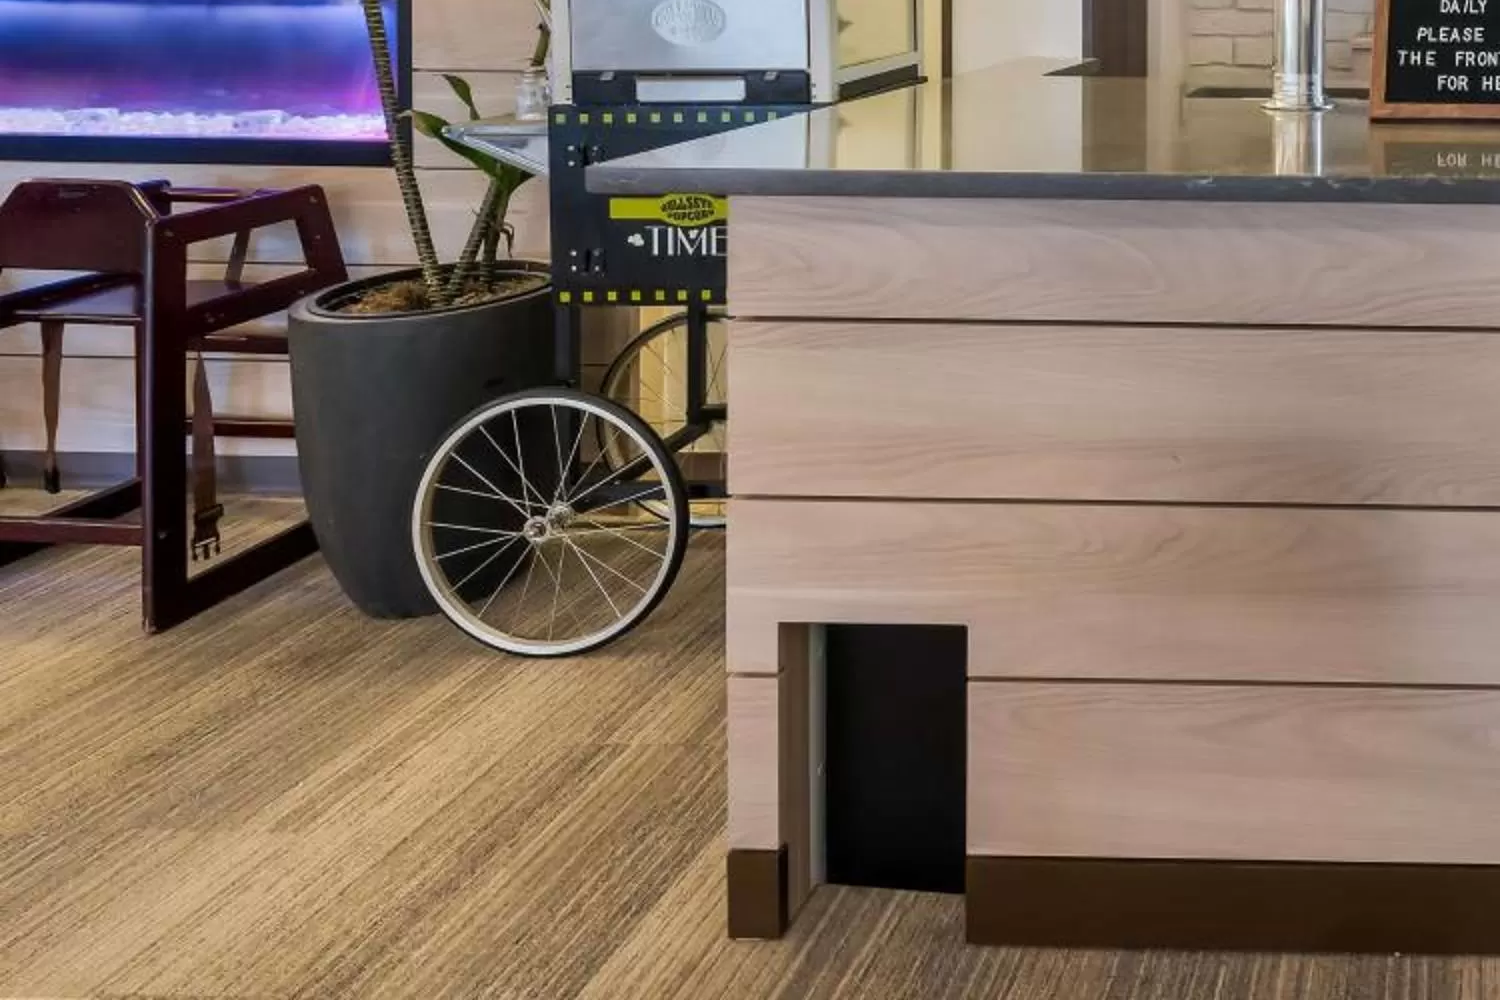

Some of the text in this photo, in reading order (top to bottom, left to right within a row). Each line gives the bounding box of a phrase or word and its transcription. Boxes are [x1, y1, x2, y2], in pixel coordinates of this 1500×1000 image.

[1416, 27, 1485, 43] PLEASE
[1397, 50, 1437, 67] THE
[1437, 75, 1469, 91] FOR
[644, 225, 728, 257] TIME
